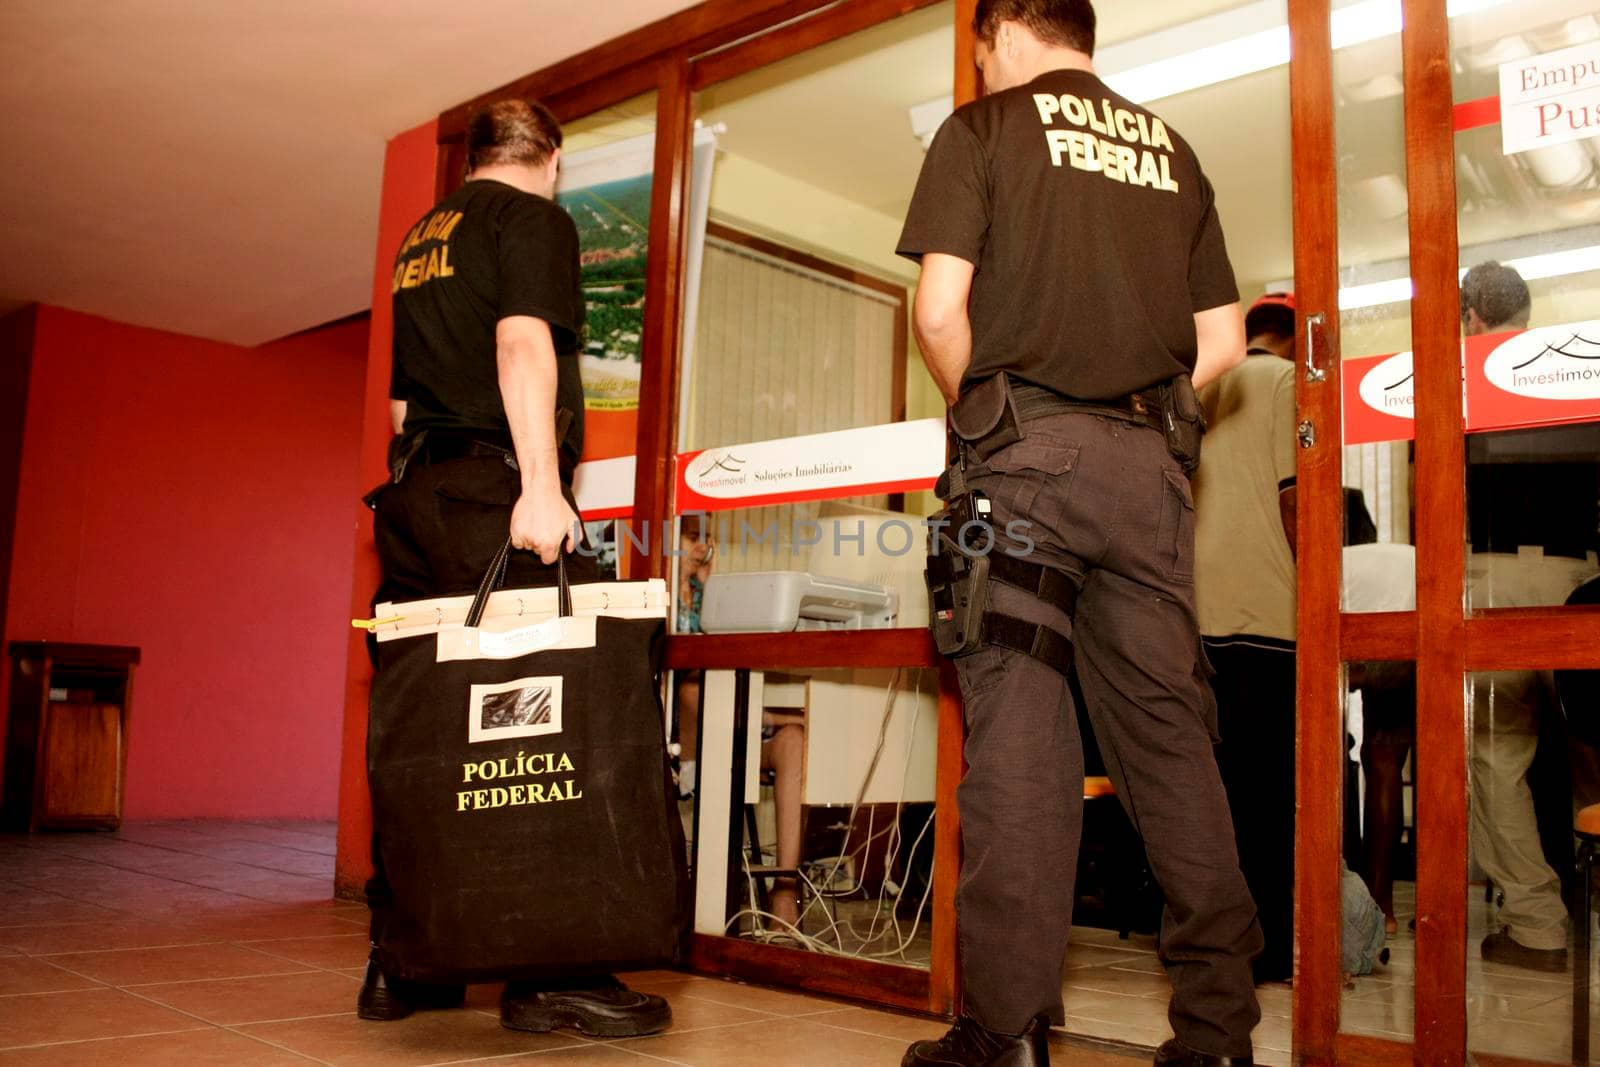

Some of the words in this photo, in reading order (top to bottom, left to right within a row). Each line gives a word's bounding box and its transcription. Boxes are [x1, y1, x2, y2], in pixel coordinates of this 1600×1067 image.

[1033, 93, 1175, 153] POLÍCIA
[1045, 129, 1179, 194] FEDERAL
[754, 469, 793, 483] Soluções
[796, 461, 852, 477] Imobiliárias
[462, 751, 575, 783] POLÍCIA
[456, 780, 583, 811] FEDERAL
